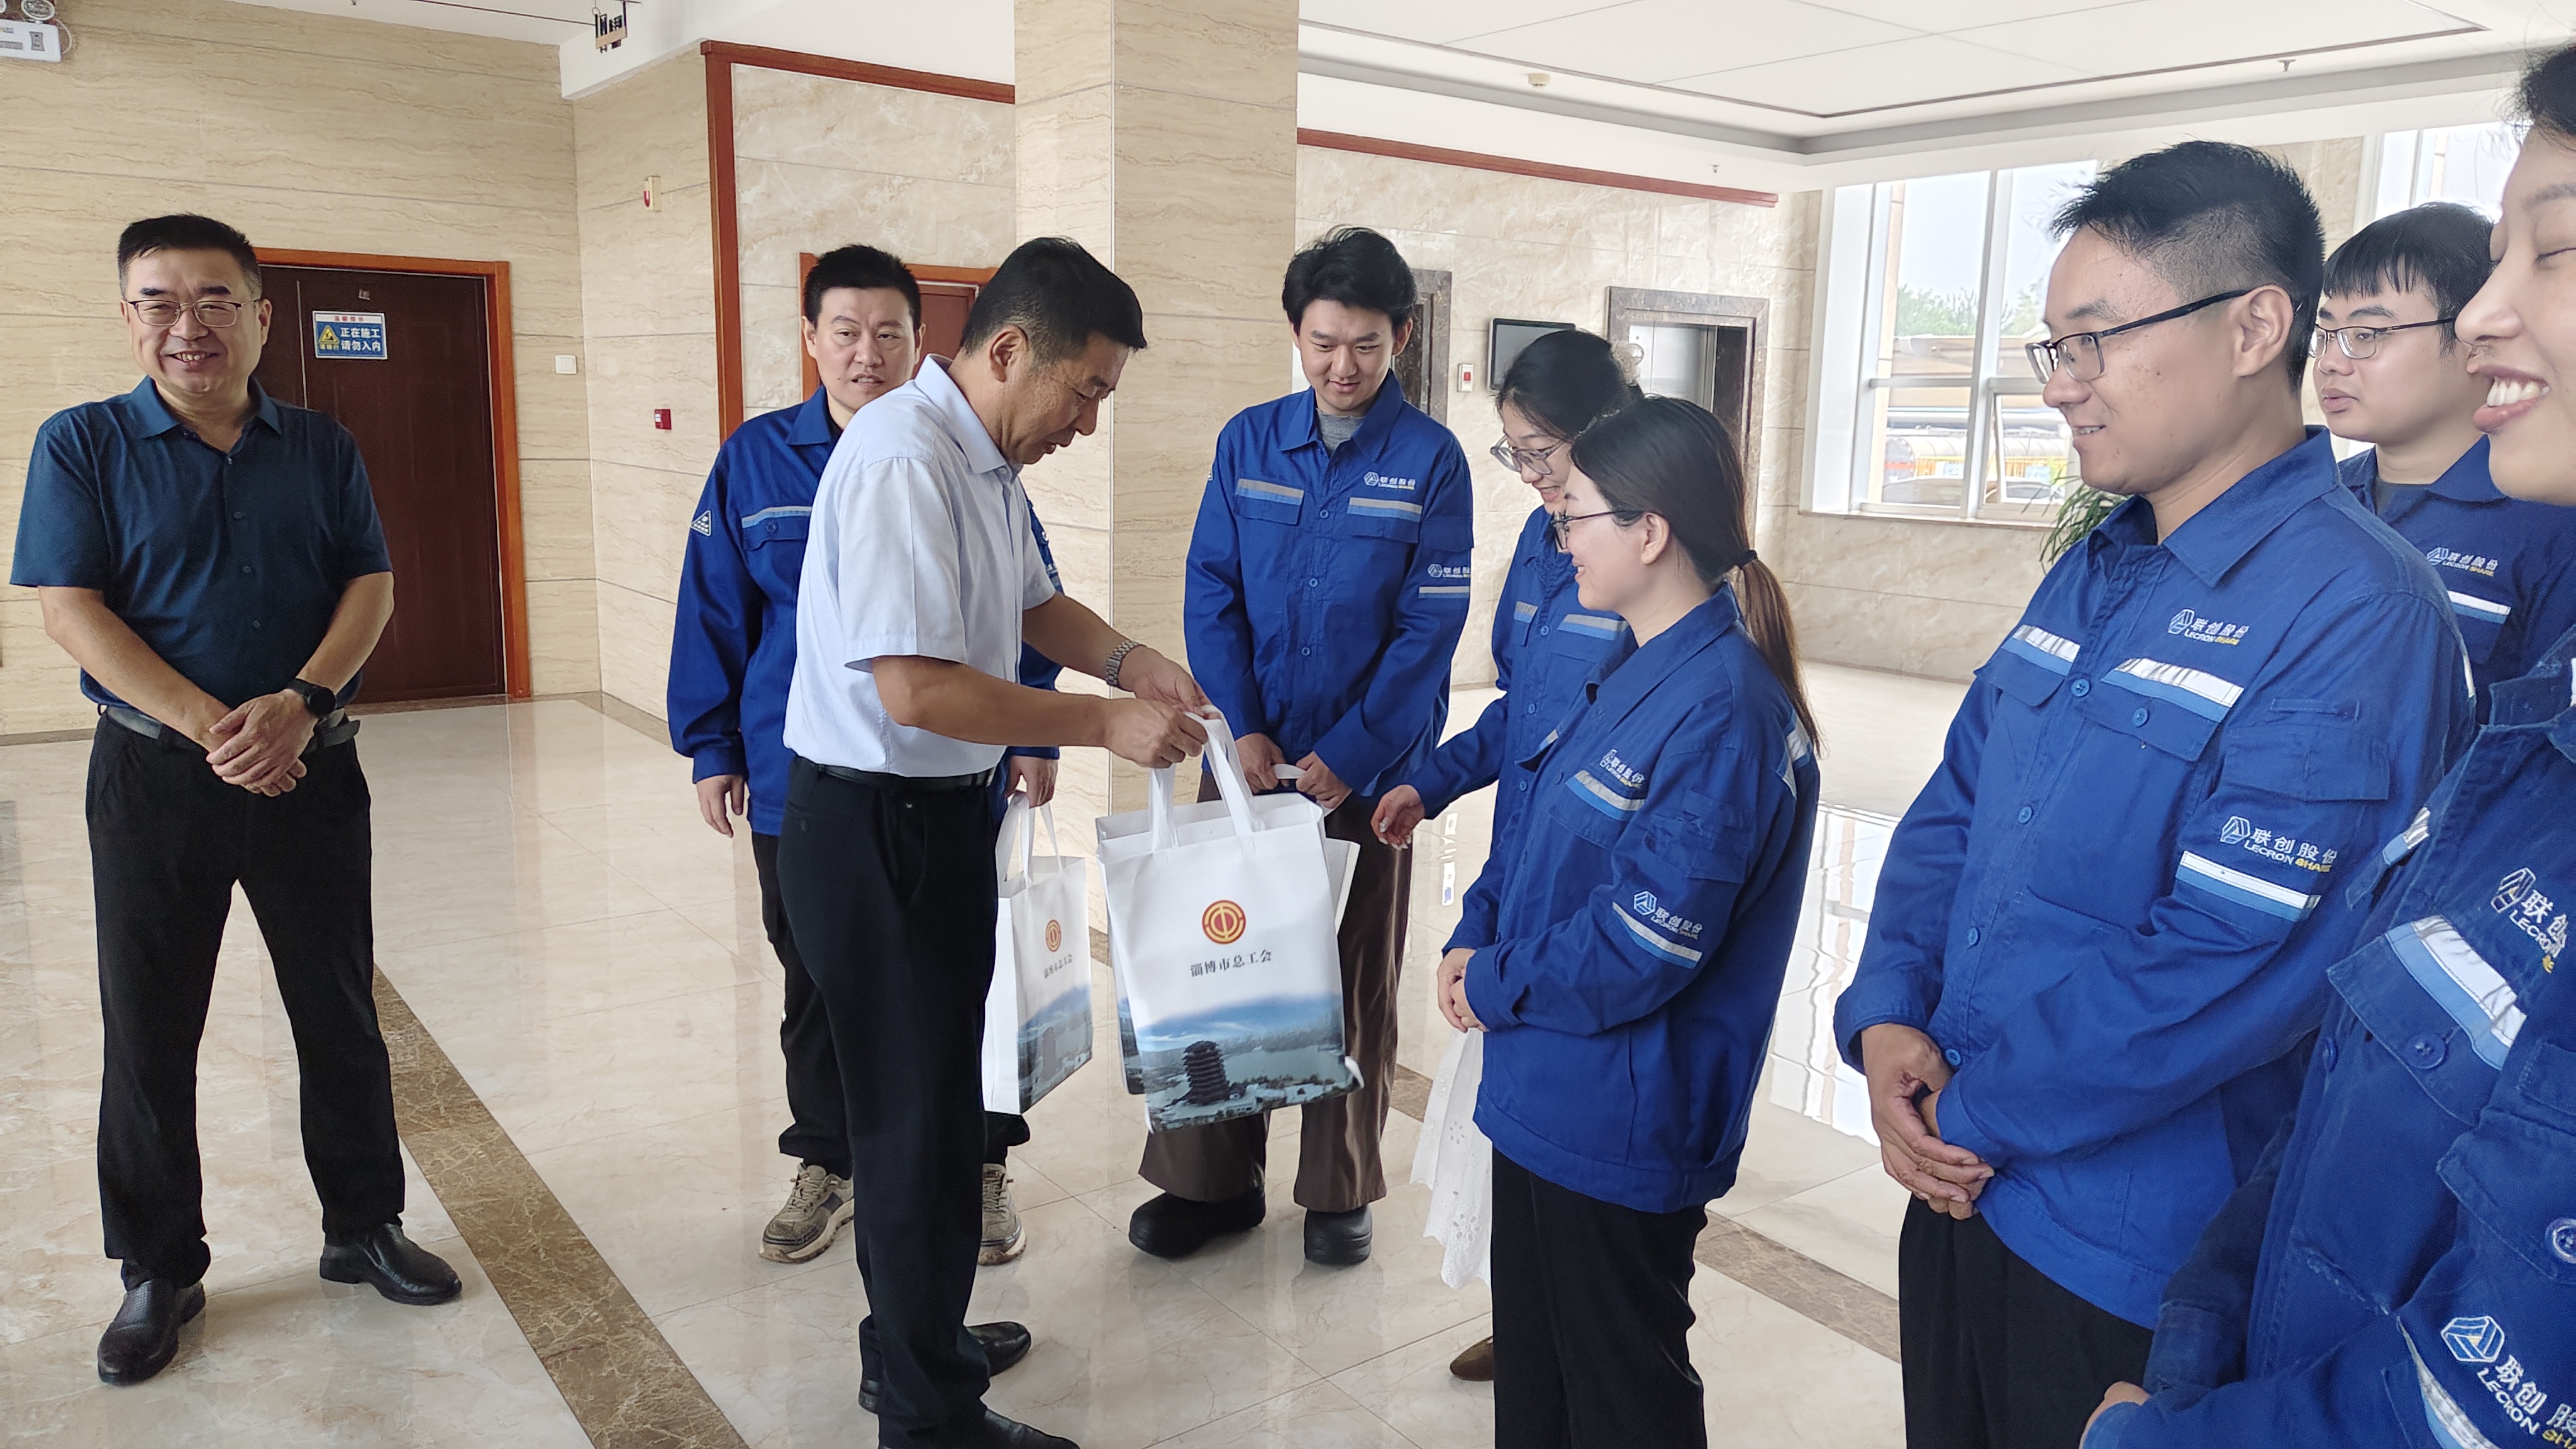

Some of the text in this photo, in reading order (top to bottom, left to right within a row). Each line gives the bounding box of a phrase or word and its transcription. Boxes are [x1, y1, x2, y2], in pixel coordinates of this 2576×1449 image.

[340, 327, 381, 338] 正在施工
[341, 340, 381, 352] 请勿入内
[2447, 552, 2498, 570] 联创股份
[2190, 618, 2250, 638] 联创股份
[2243, 840, 2294, 865] LECRON
[2250, 828, 2338, 863] 联创股份
[1655, 907, 1702, 933] 联创股份
[1191, 949, 1271, 977] 淄博市总工会
[2477, 1367, 2540, 1435] LECRON
